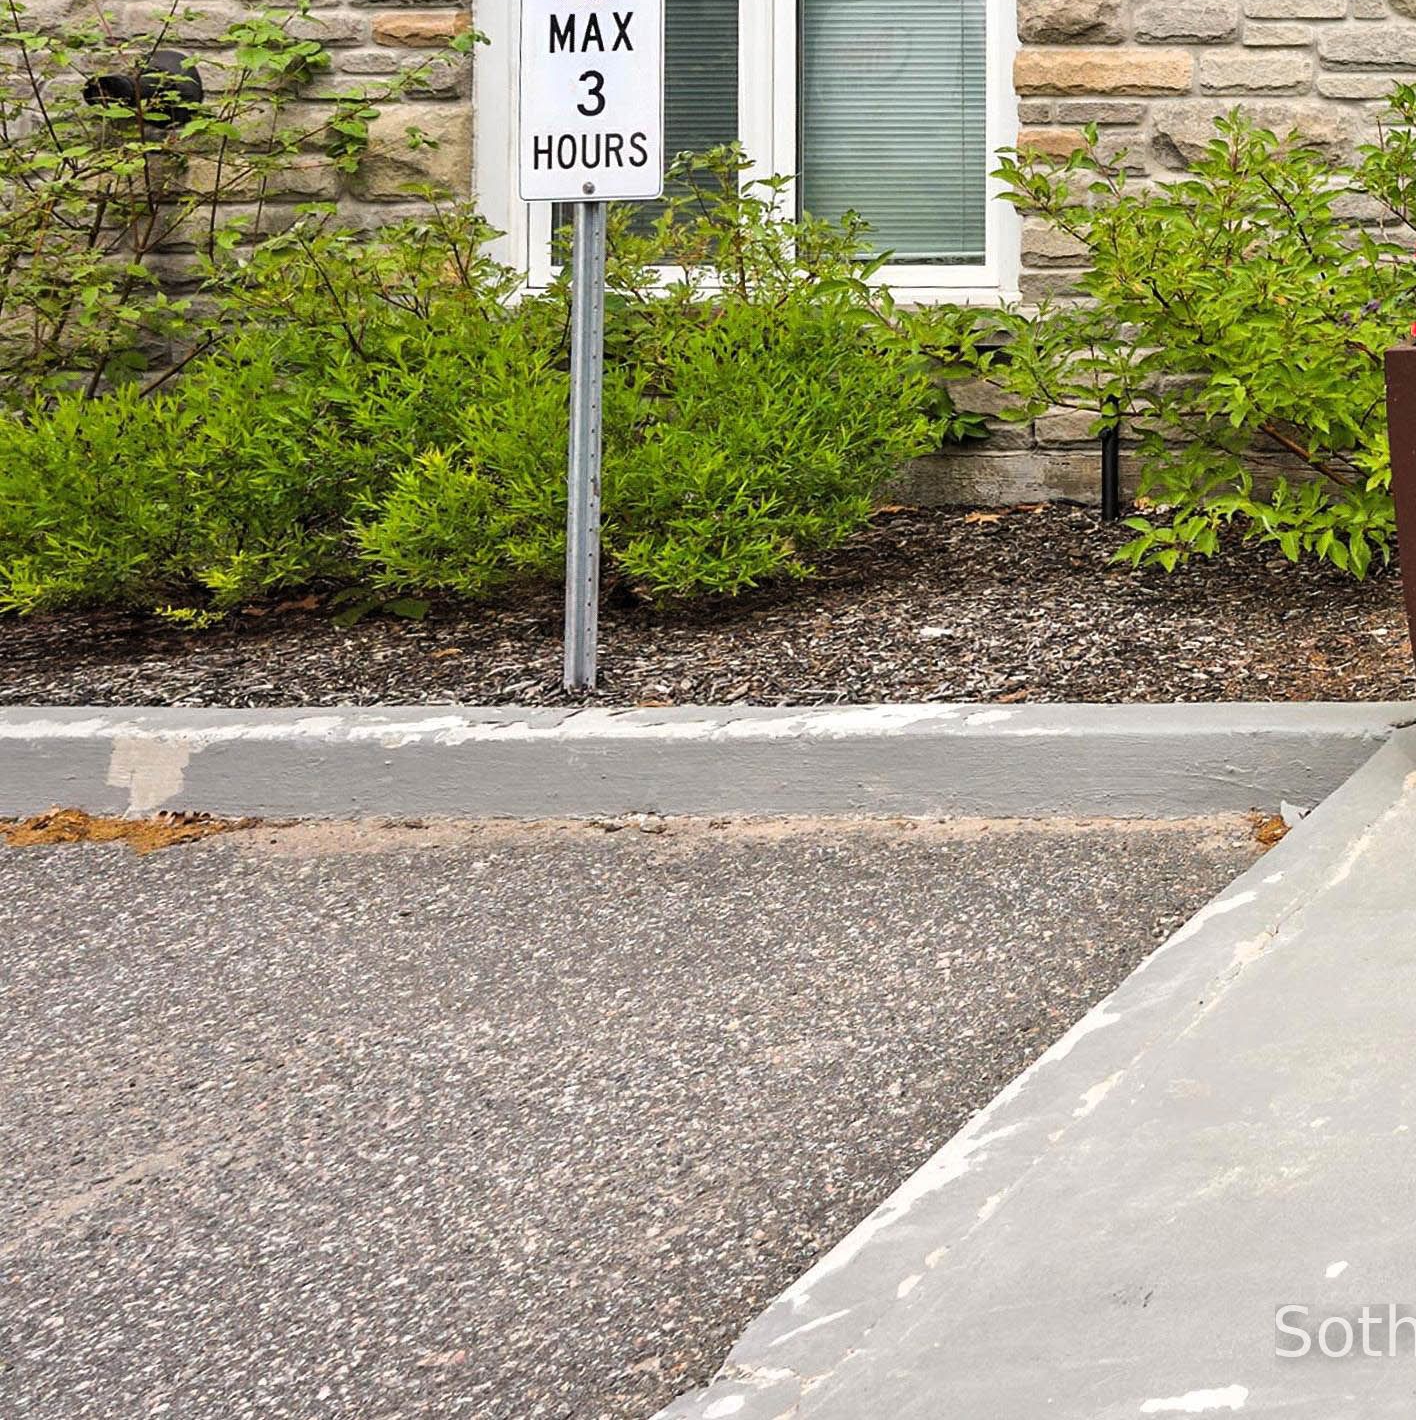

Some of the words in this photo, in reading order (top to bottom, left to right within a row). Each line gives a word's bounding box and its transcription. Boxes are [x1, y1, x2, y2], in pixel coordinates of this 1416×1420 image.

[548, 11, 635, 53] MAX
[576, 70, 606, 117] 3
[533, 132, 649, 170] HOURS
